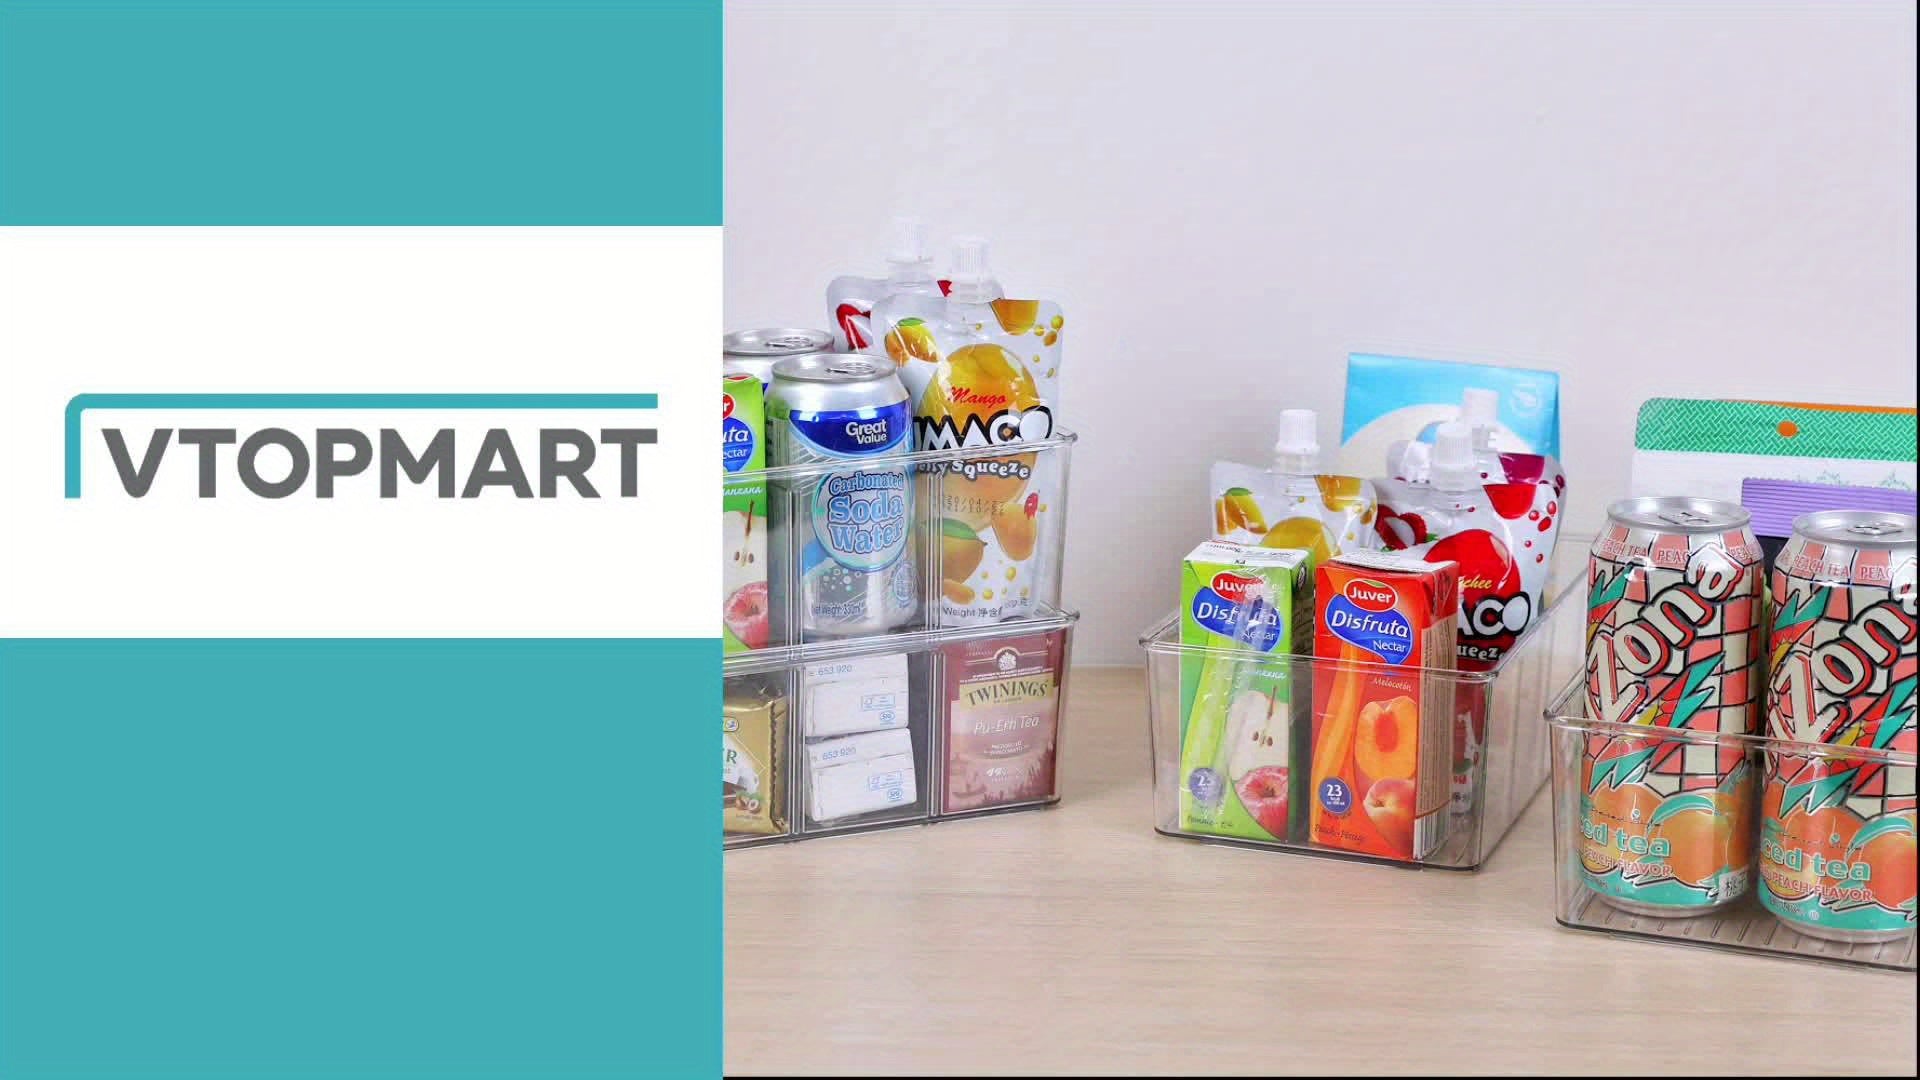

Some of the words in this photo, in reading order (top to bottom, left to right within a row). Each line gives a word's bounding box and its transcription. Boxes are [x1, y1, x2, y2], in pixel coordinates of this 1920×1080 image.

[949, 386, 1008, 408] Mango
[845, 419, 887, 436] Great
[857, 432, 887, 445] Value
[722, 447, 748, 460] ectar
[950, 459, 1031, 482] Squeeze
[828, 470, 904, 496] Carbonated
[827, 488, 904, 525] Soda
[827, 516, 904, 554] Water
[1827, 562, 1850, 577] TEA
[1349, 587, 1393, 604] Juver
[1330, 609, 1409, 639] Disfruta
[1373, 639, 1407, 653] Nectar
[966, 680, 1048, 707] TWININGS
[1326, 784, 1343, 797] 23
[1615, 826, 1673, 858] tea
[1616, 858, 1674, 878] FLAVOR
[1812, 852, 1872, 882] tea
[1812, 885, 1873, 902] FLAVOR
